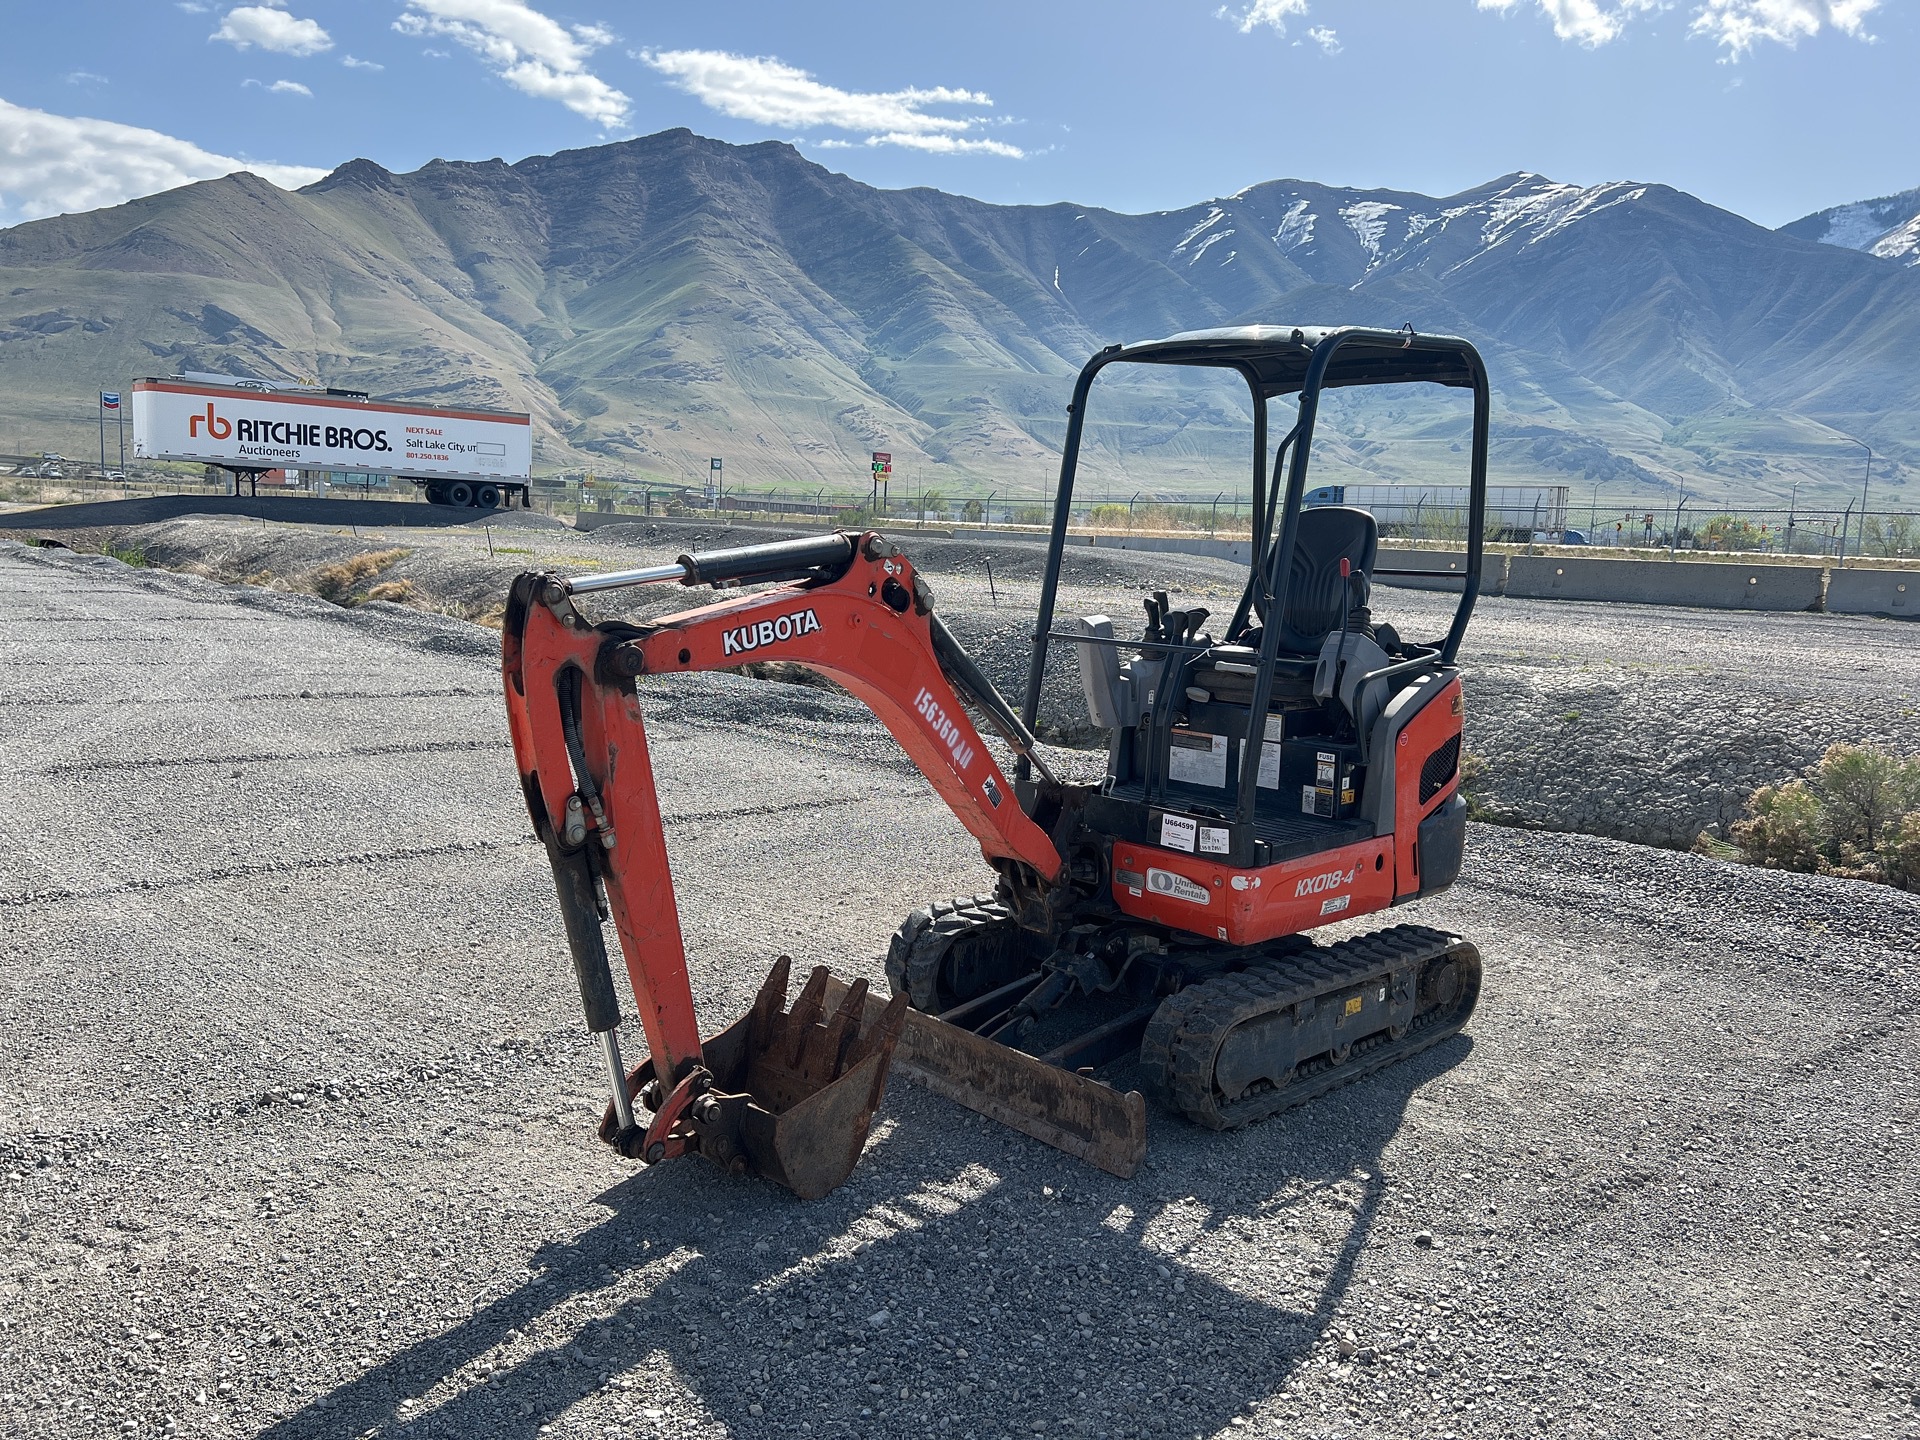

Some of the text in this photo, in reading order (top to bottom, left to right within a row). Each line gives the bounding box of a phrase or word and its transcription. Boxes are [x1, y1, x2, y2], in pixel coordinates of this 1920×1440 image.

[190, 402, 232, 440] rb
[237, 418, 393, 452] RITCHIE BROS.
[406, 426, 443, 436] NEXT SALE
[238, 444, 301, 459] Auctioneers
[406, 439, 477, 454] Salt Lake City, UT
[406, 452, 449, 461] 801.250.1836
[722, 608, 822, 657] KUBOTA
[1318, 753, 1334, 761] FUSE
[1164, 818, 1195, 831] U664599
[1294, 869, 1355, 898] KX018-4
[1173, 885, 1207, 901] Rentals
